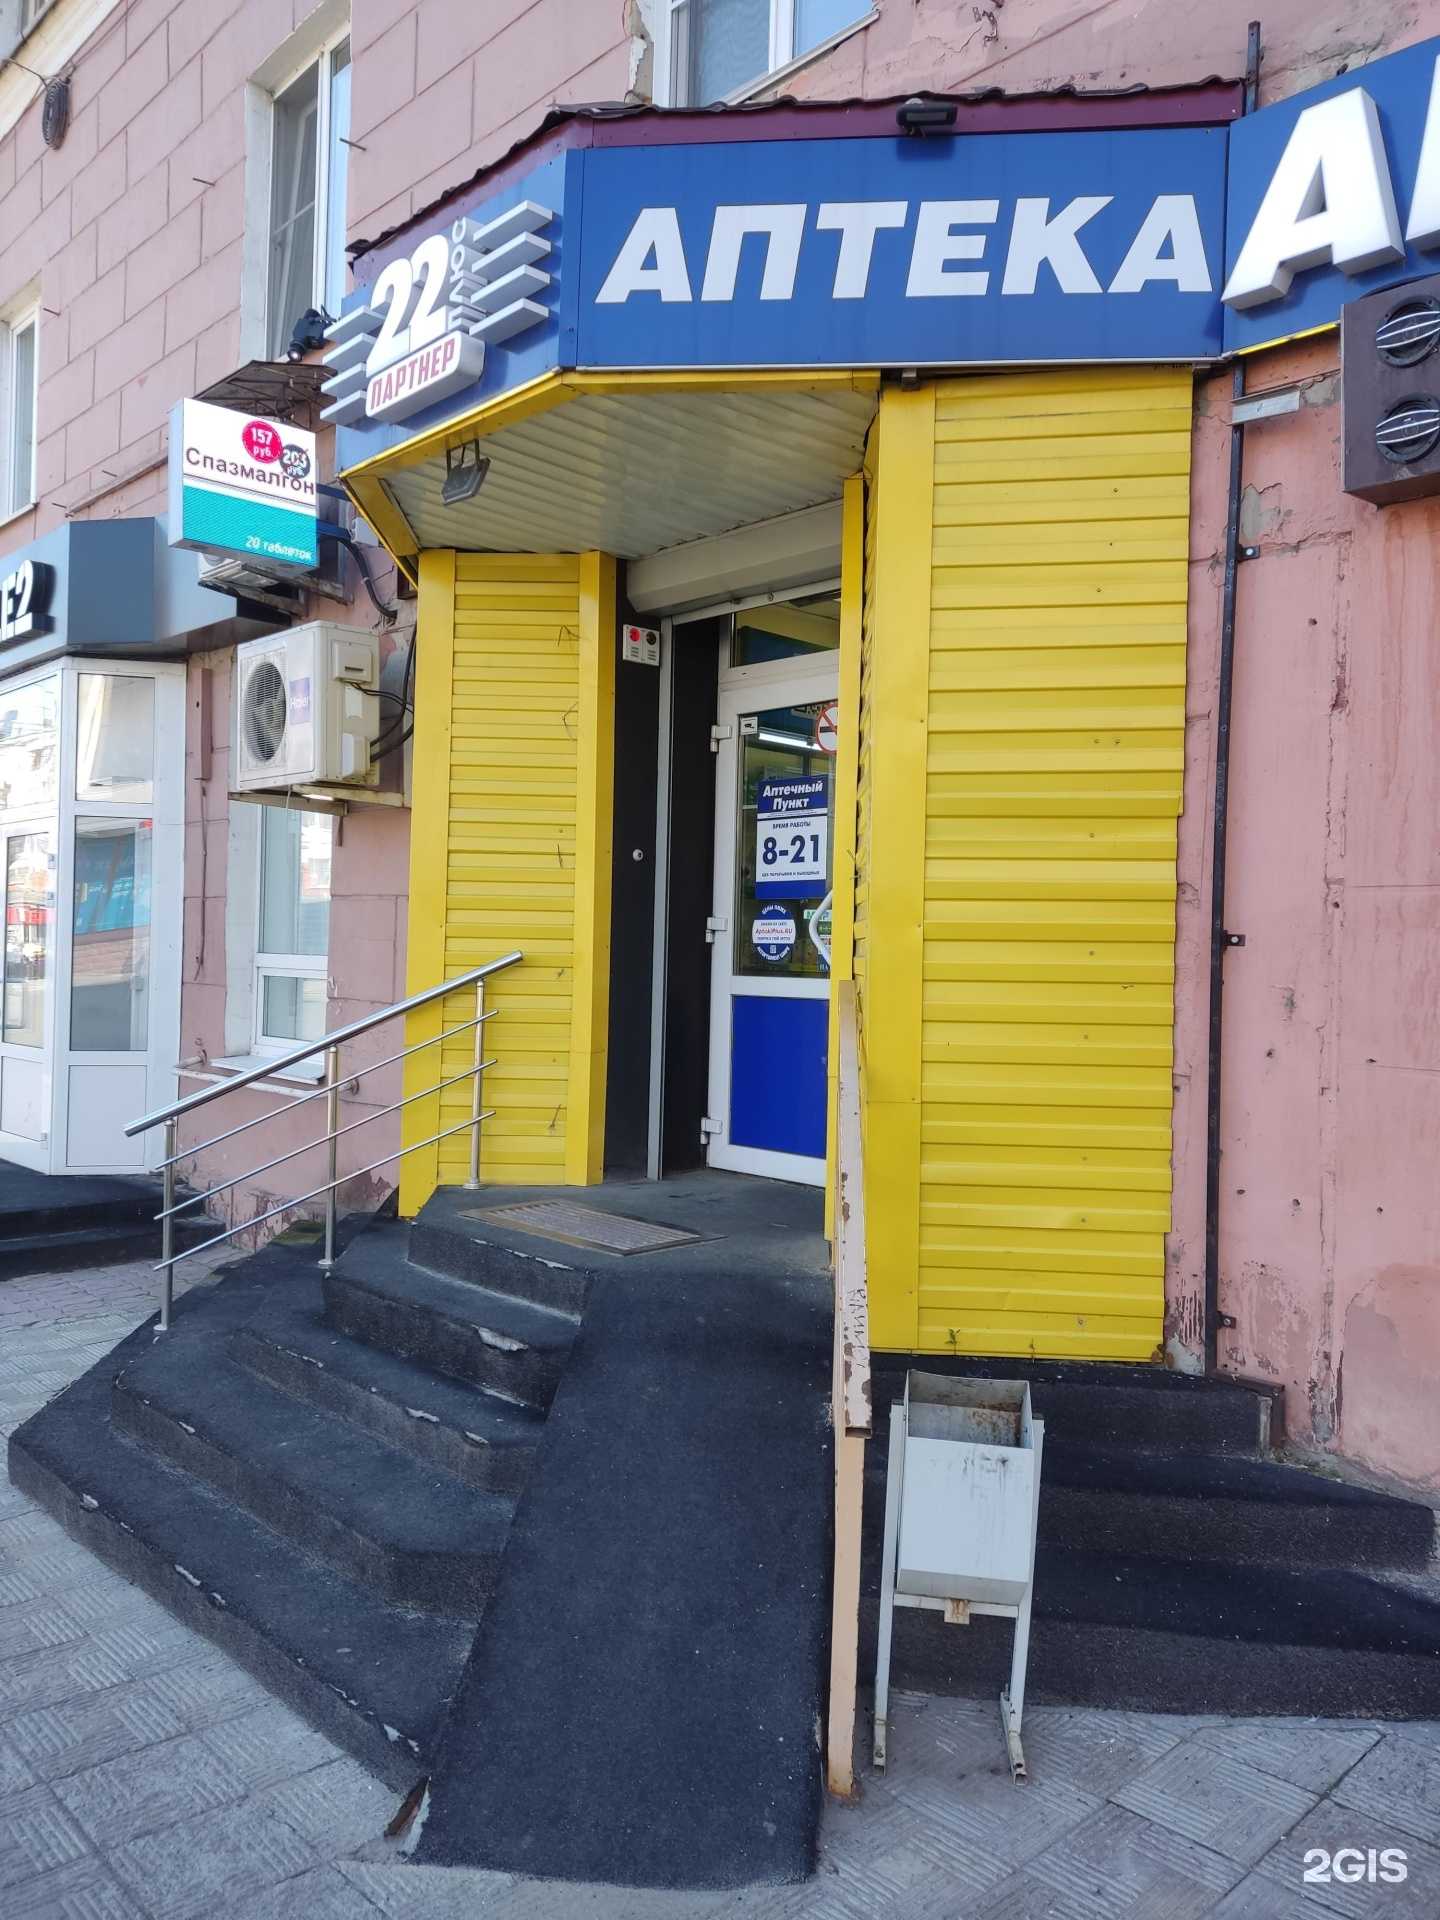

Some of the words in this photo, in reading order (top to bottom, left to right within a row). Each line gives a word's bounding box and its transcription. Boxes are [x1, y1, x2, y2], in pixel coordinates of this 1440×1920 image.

[1220, 54, 1440, 310] А
[448, 216, 467, 331] ПЛЮС
[594, 193, 1213, 304] АПТЕКА
[366, 234, 449, 378] 22
[370, 338, 456, 410] ПАРТНЕР
[252, 427, 273, 444] 157
[186, 447, 314, 495] Спазмалгон
[246, 536, 260, 549] 20
[263, 540, 312, 561] таблеток
[0, 560, 34, 641] E2
[763, 780, 823, 797] Аптечный
[773, 797, 810, 811] Пункт
[762, 834, 820, 865] 8-21
